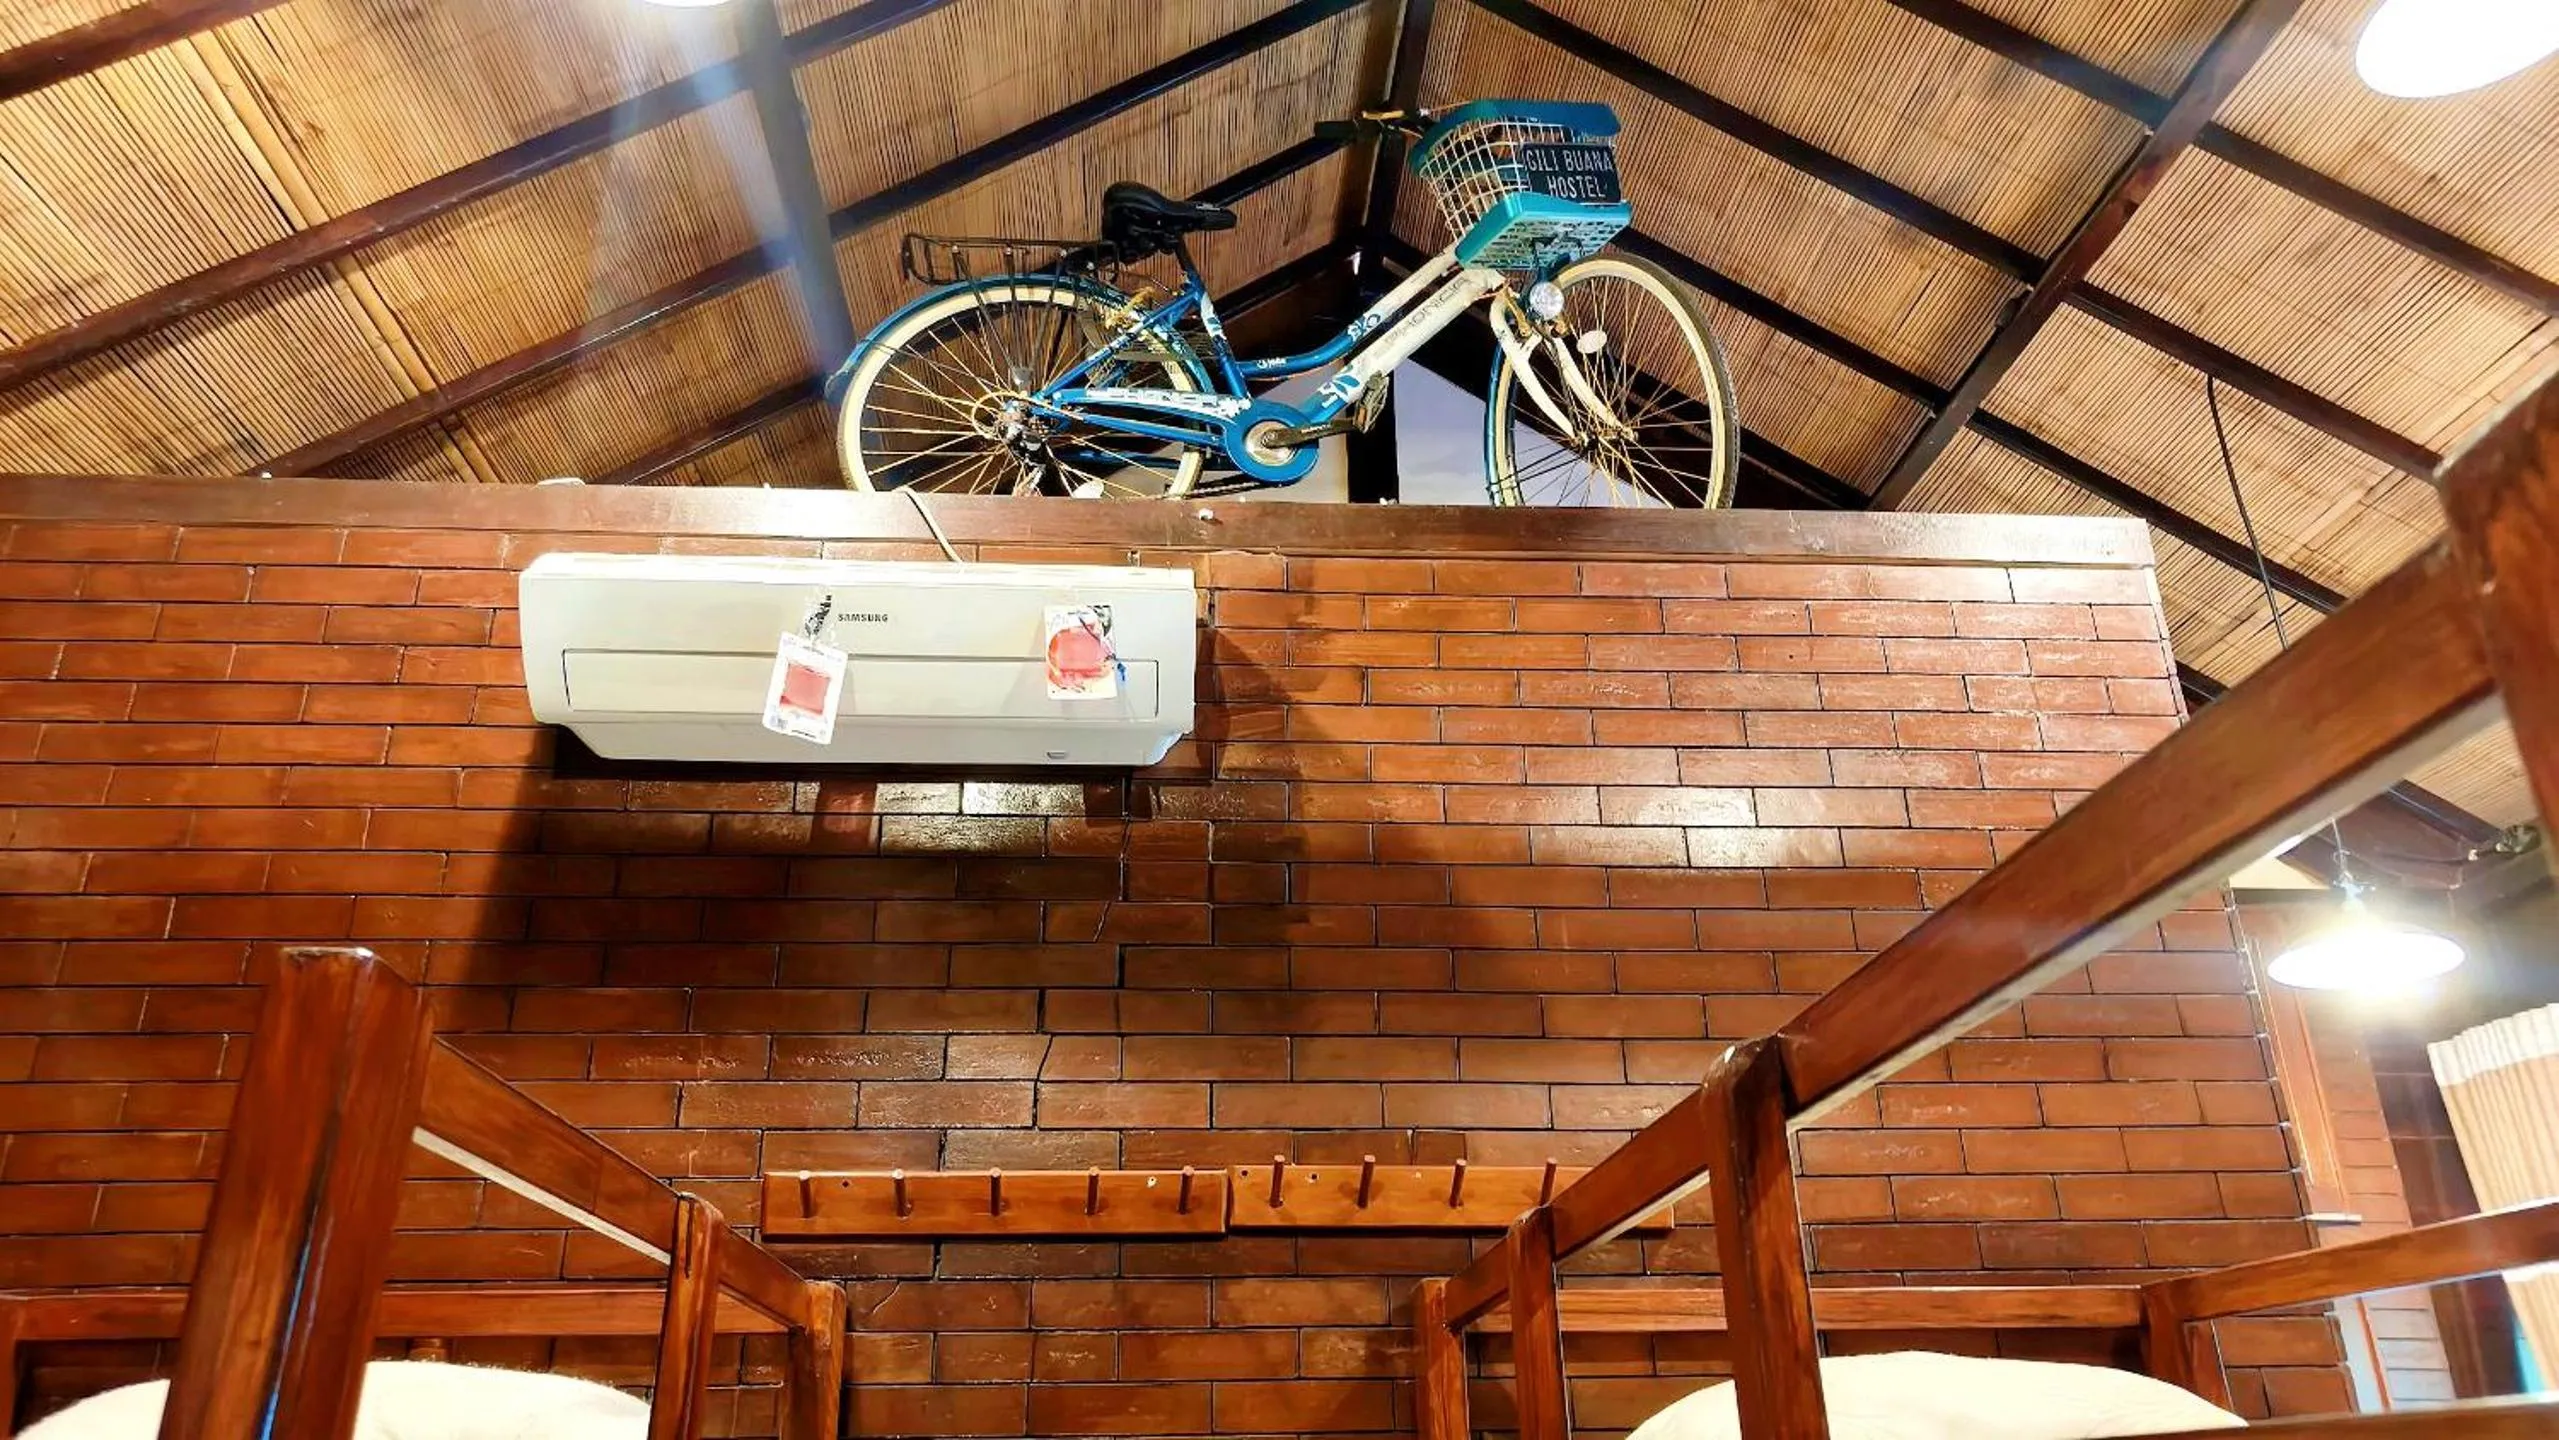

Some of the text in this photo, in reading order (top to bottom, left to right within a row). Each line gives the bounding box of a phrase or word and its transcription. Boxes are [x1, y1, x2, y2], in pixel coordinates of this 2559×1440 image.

[1526, 149, 1614, 172] GILI BUANA
[1547, 175, 1606, 198] HOSTEL
[837, 613, 888, 622] SAMSUNG
